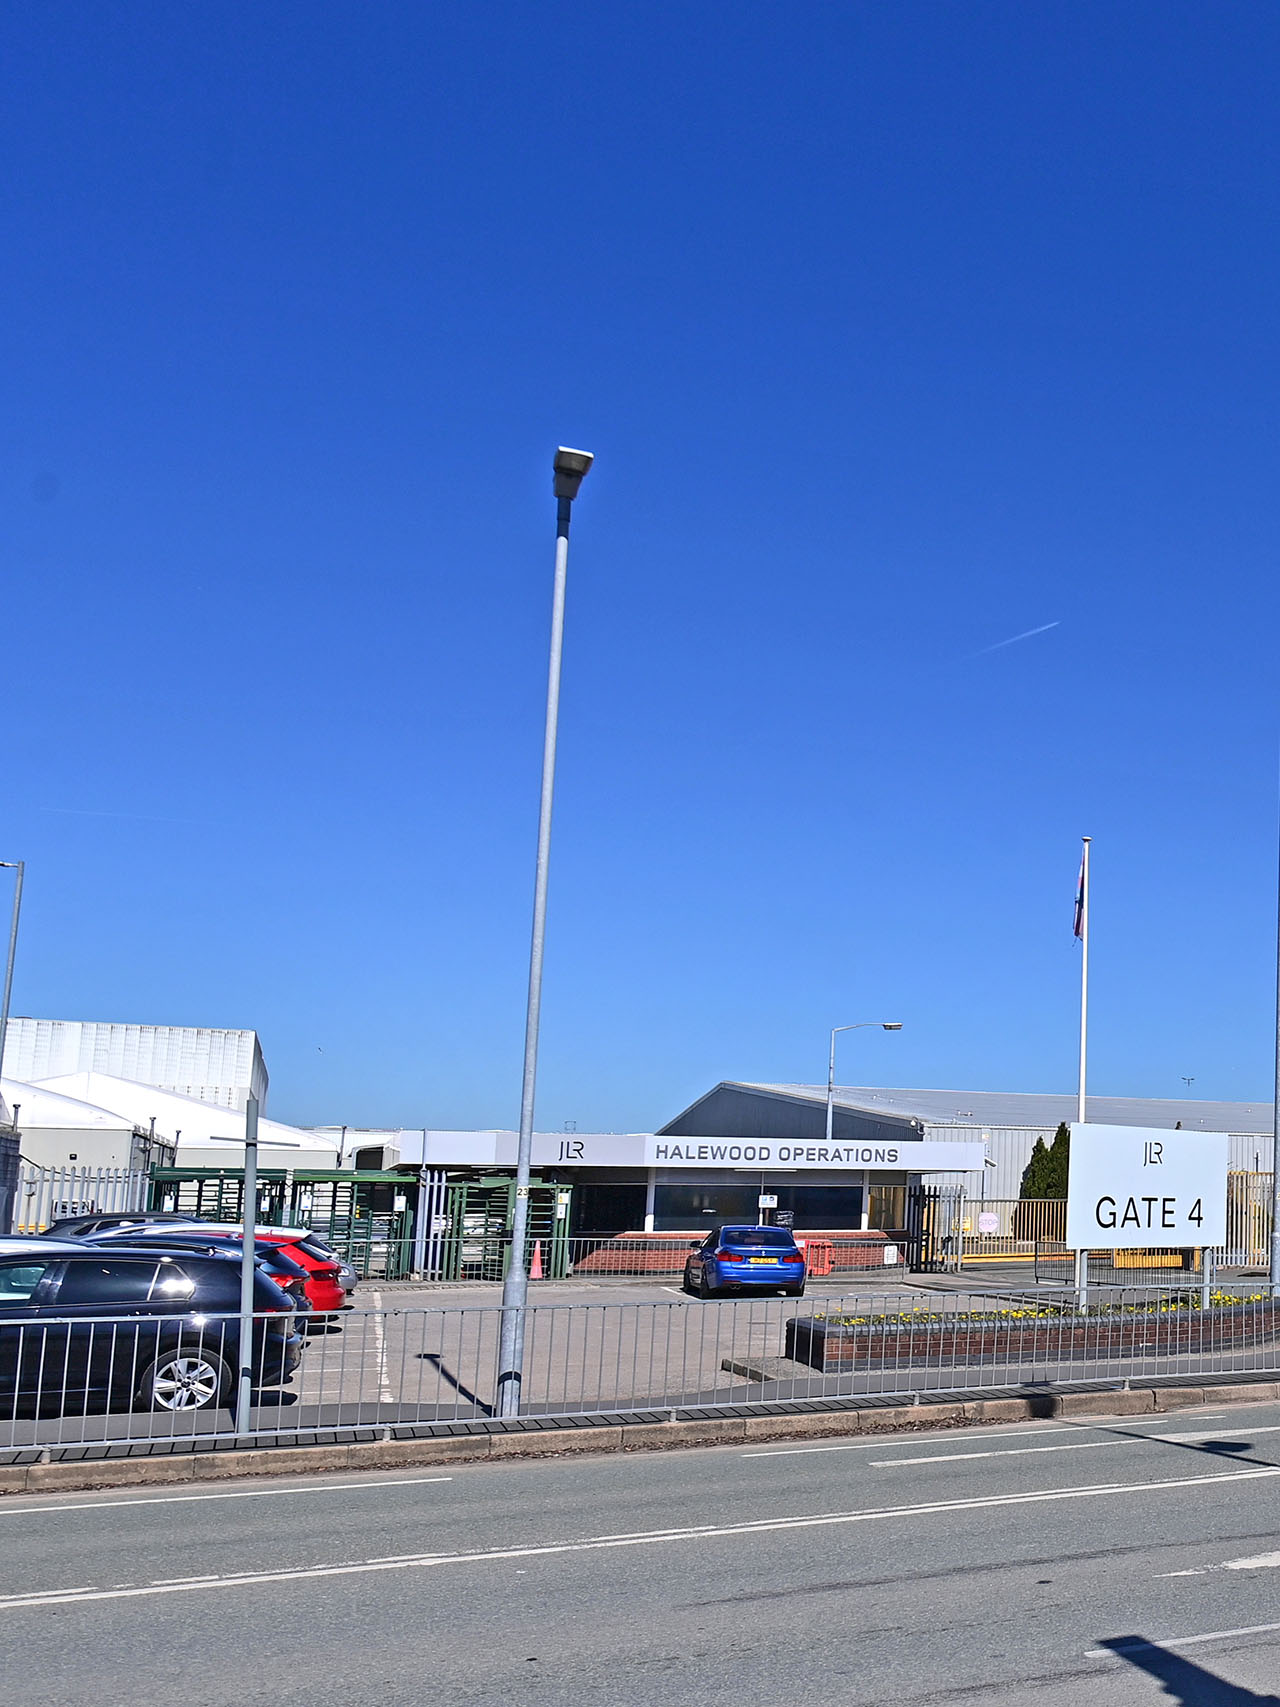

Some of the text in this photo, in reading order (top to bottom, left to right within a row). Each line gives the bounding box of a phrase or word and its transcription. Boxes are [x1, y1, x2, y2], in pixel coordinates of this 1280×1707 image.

[558, 1140, 585, 1162] JLR
[655, 1144, 899, 1163] HALEWOOD OPERATIONS
[1143, 1141, 1164, 1167] JLR
[517, 1187, 528, 1196] 23
[979, 1218, 998, 1226] STOP
[1095, 1196, 1204, 1228] GATE 4
